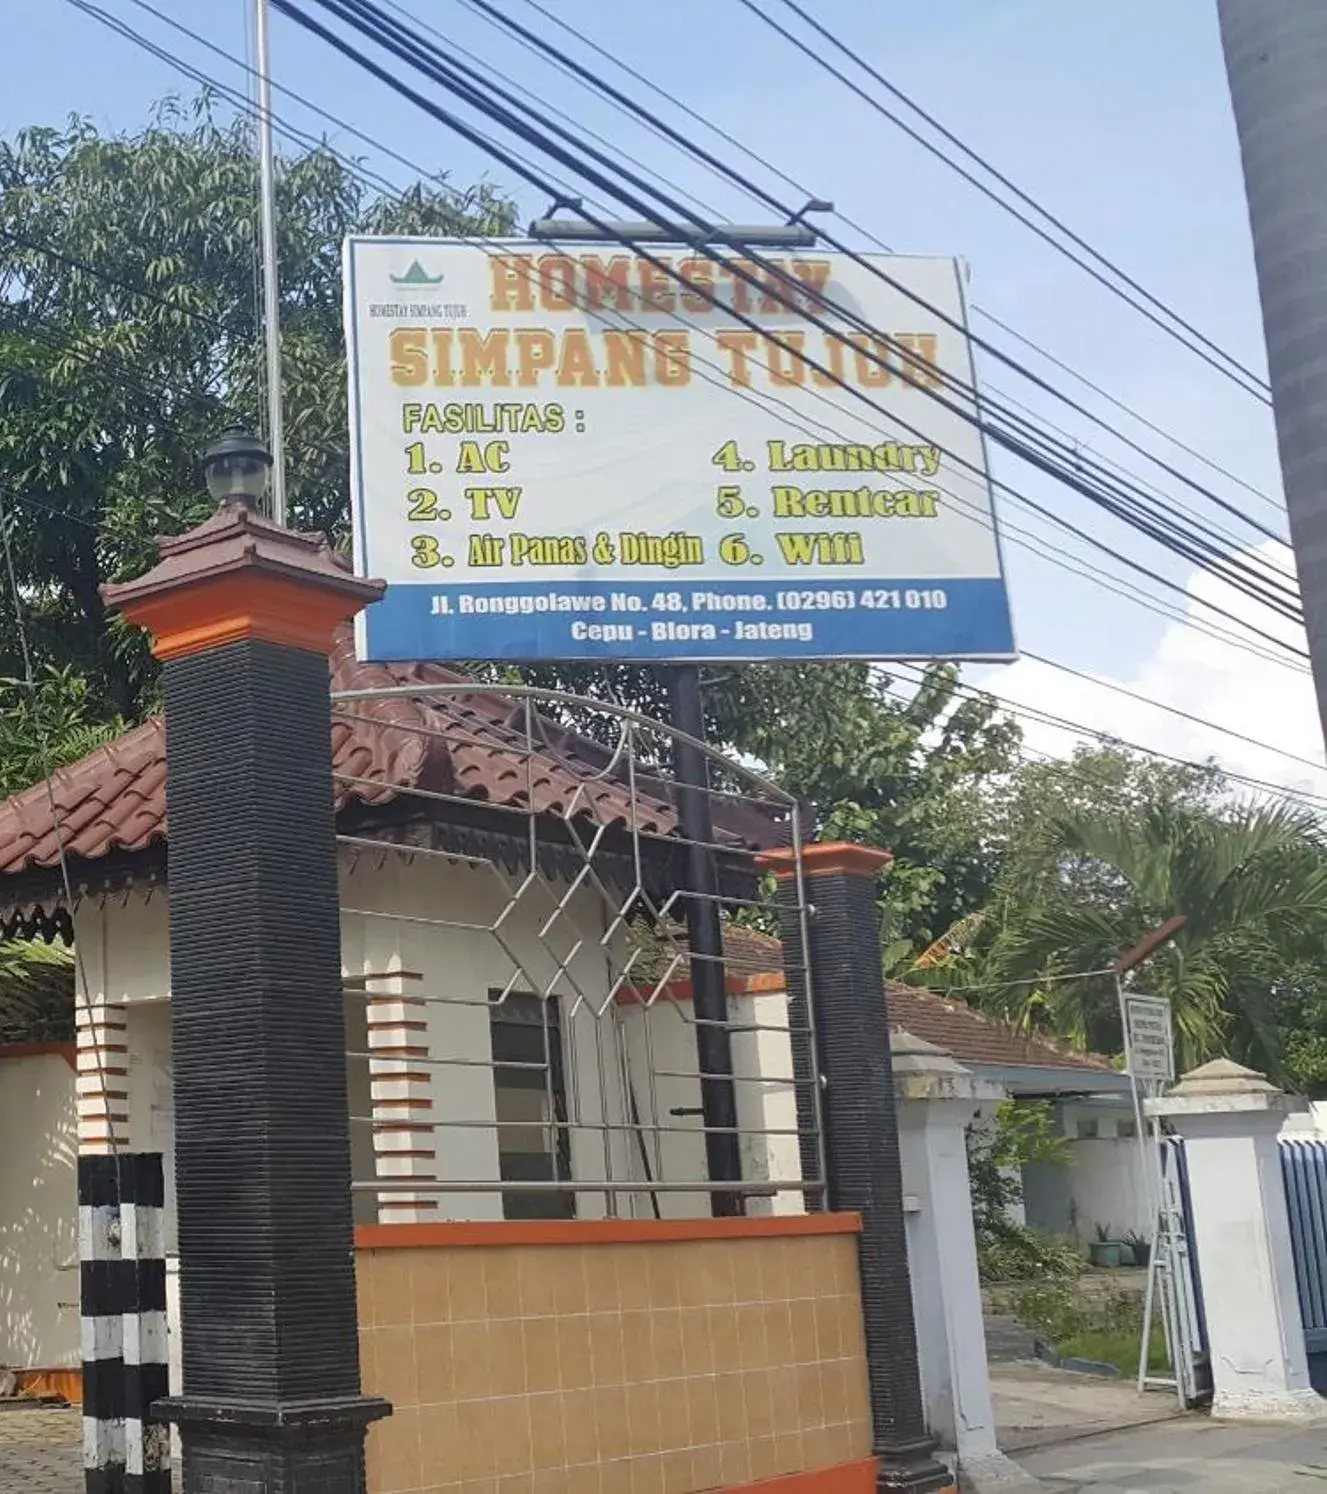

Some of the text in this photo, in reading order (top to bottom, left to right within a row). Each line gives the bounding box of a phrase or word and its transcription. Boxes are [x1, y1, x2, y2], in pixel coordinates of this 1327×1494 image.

[488, 253, 831, 314] HOMESTAY
[389, 327, 948, 389] SIMPANG TUJUH
[403, 403, 565, 433] FASILITAS
[405, 441, 510, 474] 1. AC
[712, 440, 941, 476] 4. Laundry
[408, 487, 522, 521] 2. TV
[716, 485, 941, 518] 5. Rentcar
[411, 532, 705, 569] 3. Air Panas & Dingin
[719, 532, 865, 565] 6. Wifi
[430, 590, 947, 615] Jl. Ronggolawe No. 48, Phone. (0296) 421 010
[571, 621, 633, 642] Cepu
[651, 622, 716, 641] Blora
[734, 621, 813, 641] Jateng
